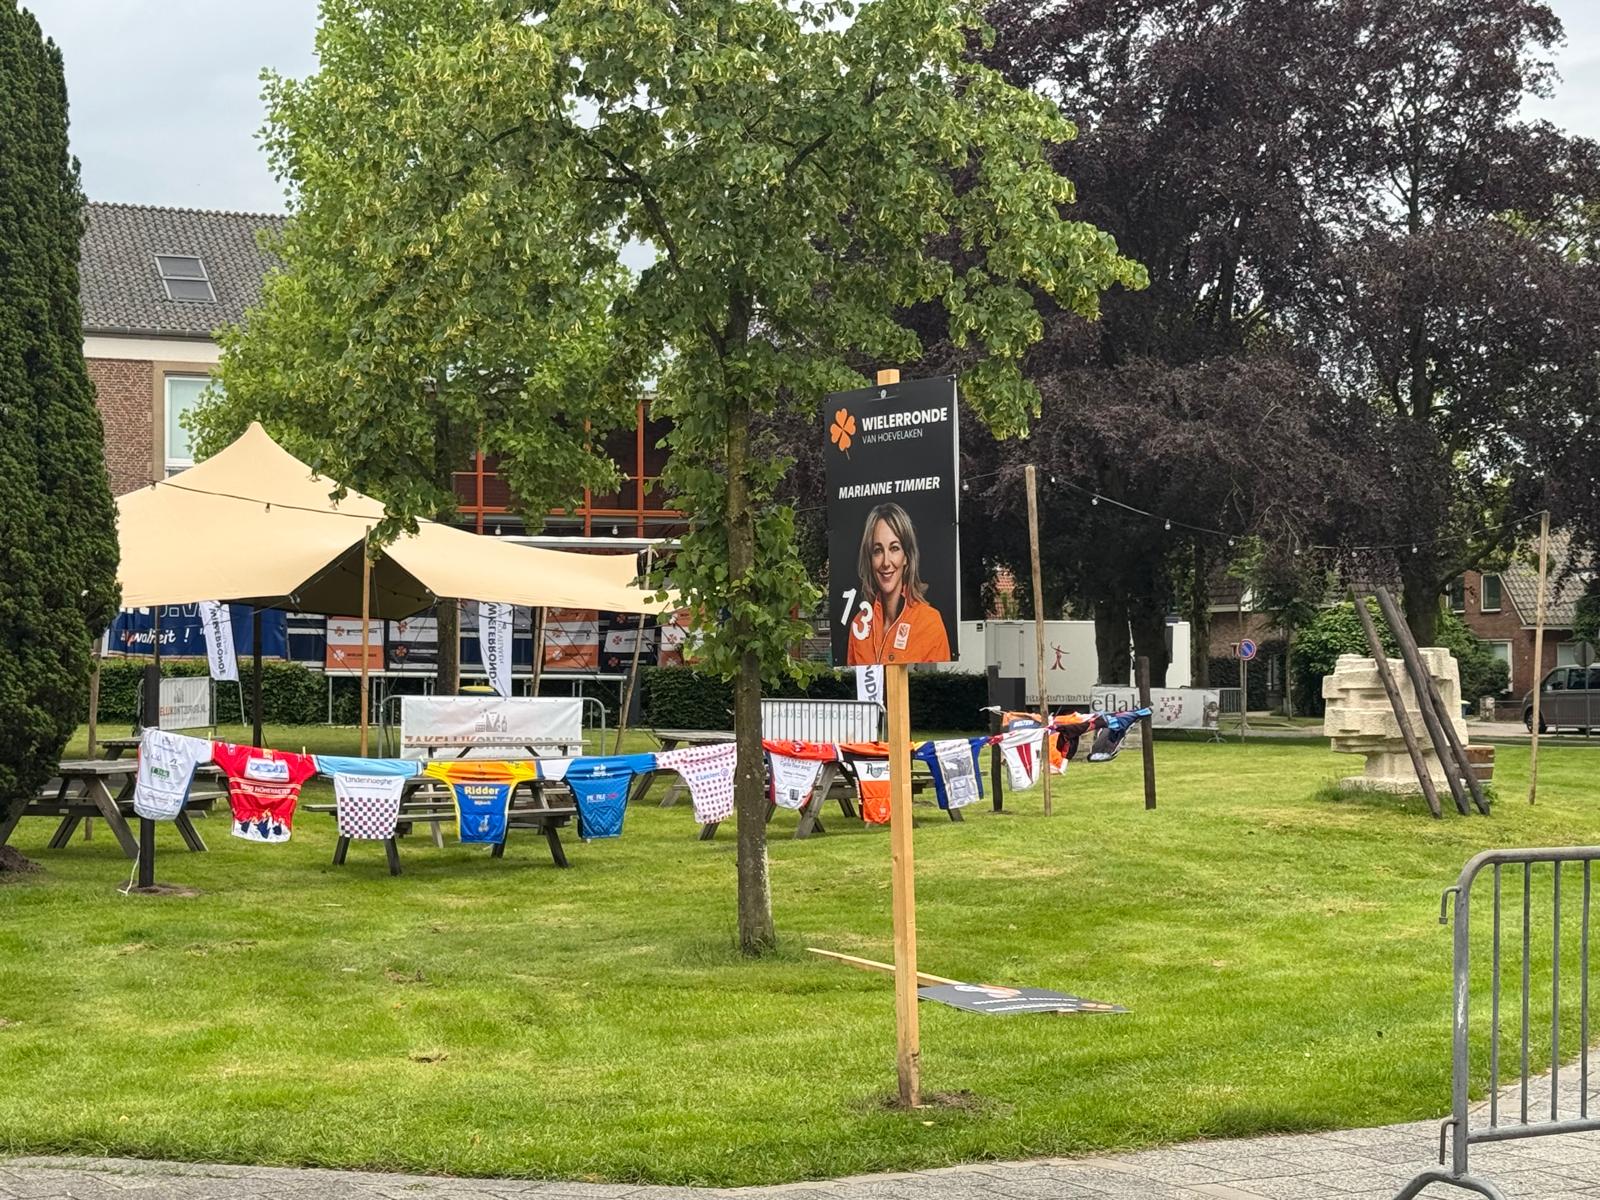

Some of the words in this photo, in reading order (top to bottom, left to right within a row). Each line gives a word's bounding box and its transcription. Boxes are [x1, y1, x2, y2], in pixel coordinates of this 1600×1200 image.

[861, 407, 948, 431] WIELERRONDE
[862, 435, 878, 444] VAN
[878, 428, 923, 442] HOEVELAKEN
[838, 481, 893, 500] MARIANNE
[895, 476, 940, 493] TIMMER
[464, 786, 501, 795] Ridder
